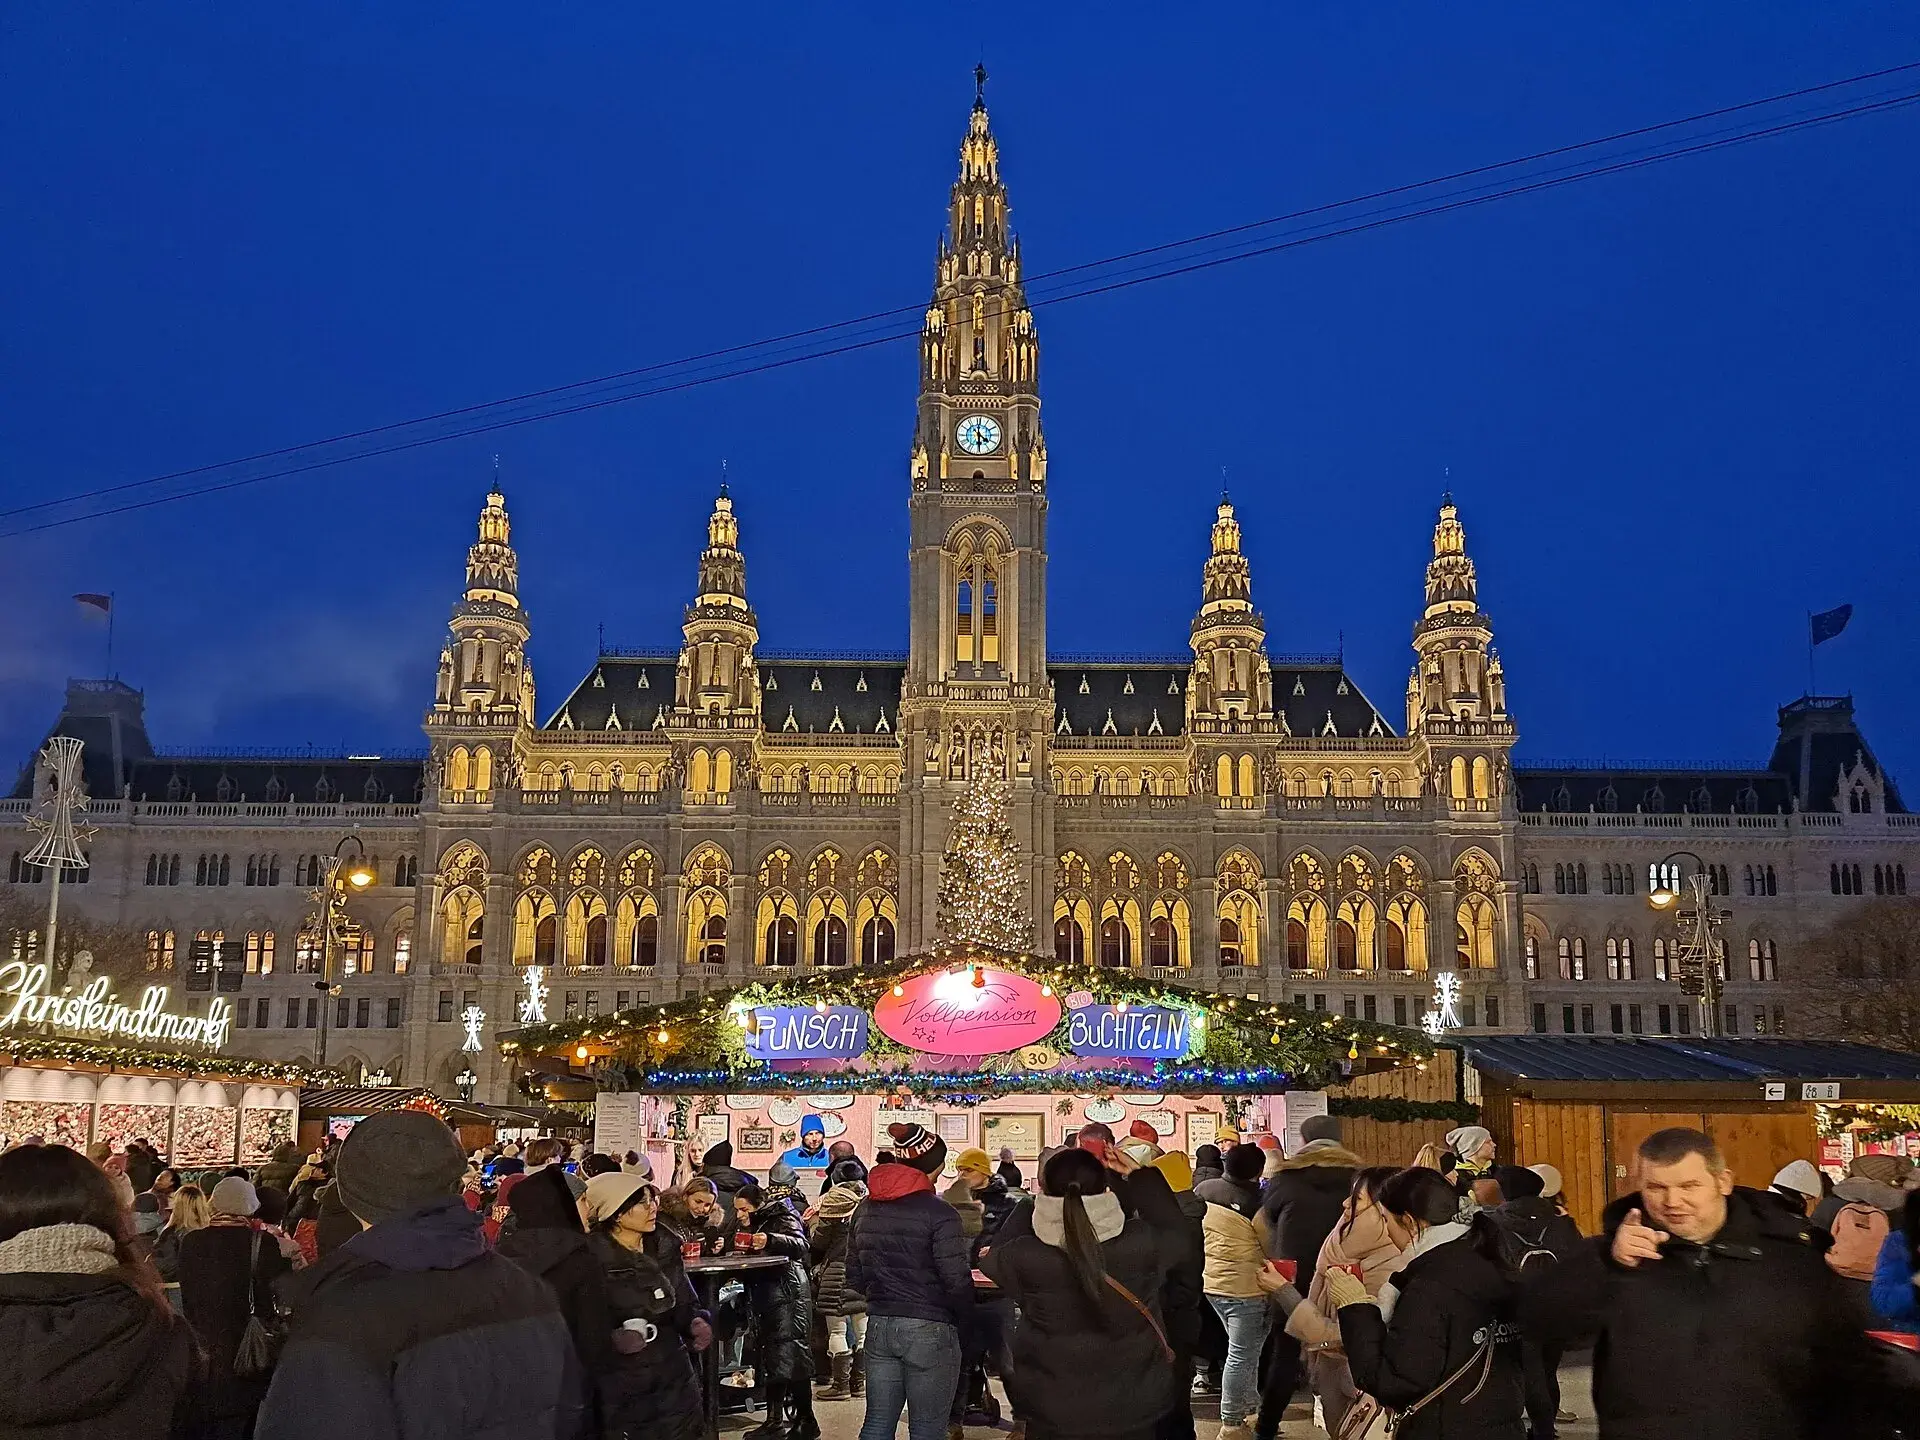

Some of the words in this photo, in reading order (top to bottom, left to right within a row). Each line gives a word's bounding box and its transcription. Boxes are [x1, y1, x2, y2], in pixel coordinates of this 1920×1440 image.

[0, 961, 232, 1048] Christkindlmarkt
[1069, 992, 1088, 1007] BIO
[898, 998, 1037, 1036] Vollpension
[1028, 1052, 1048, 1066] 30
